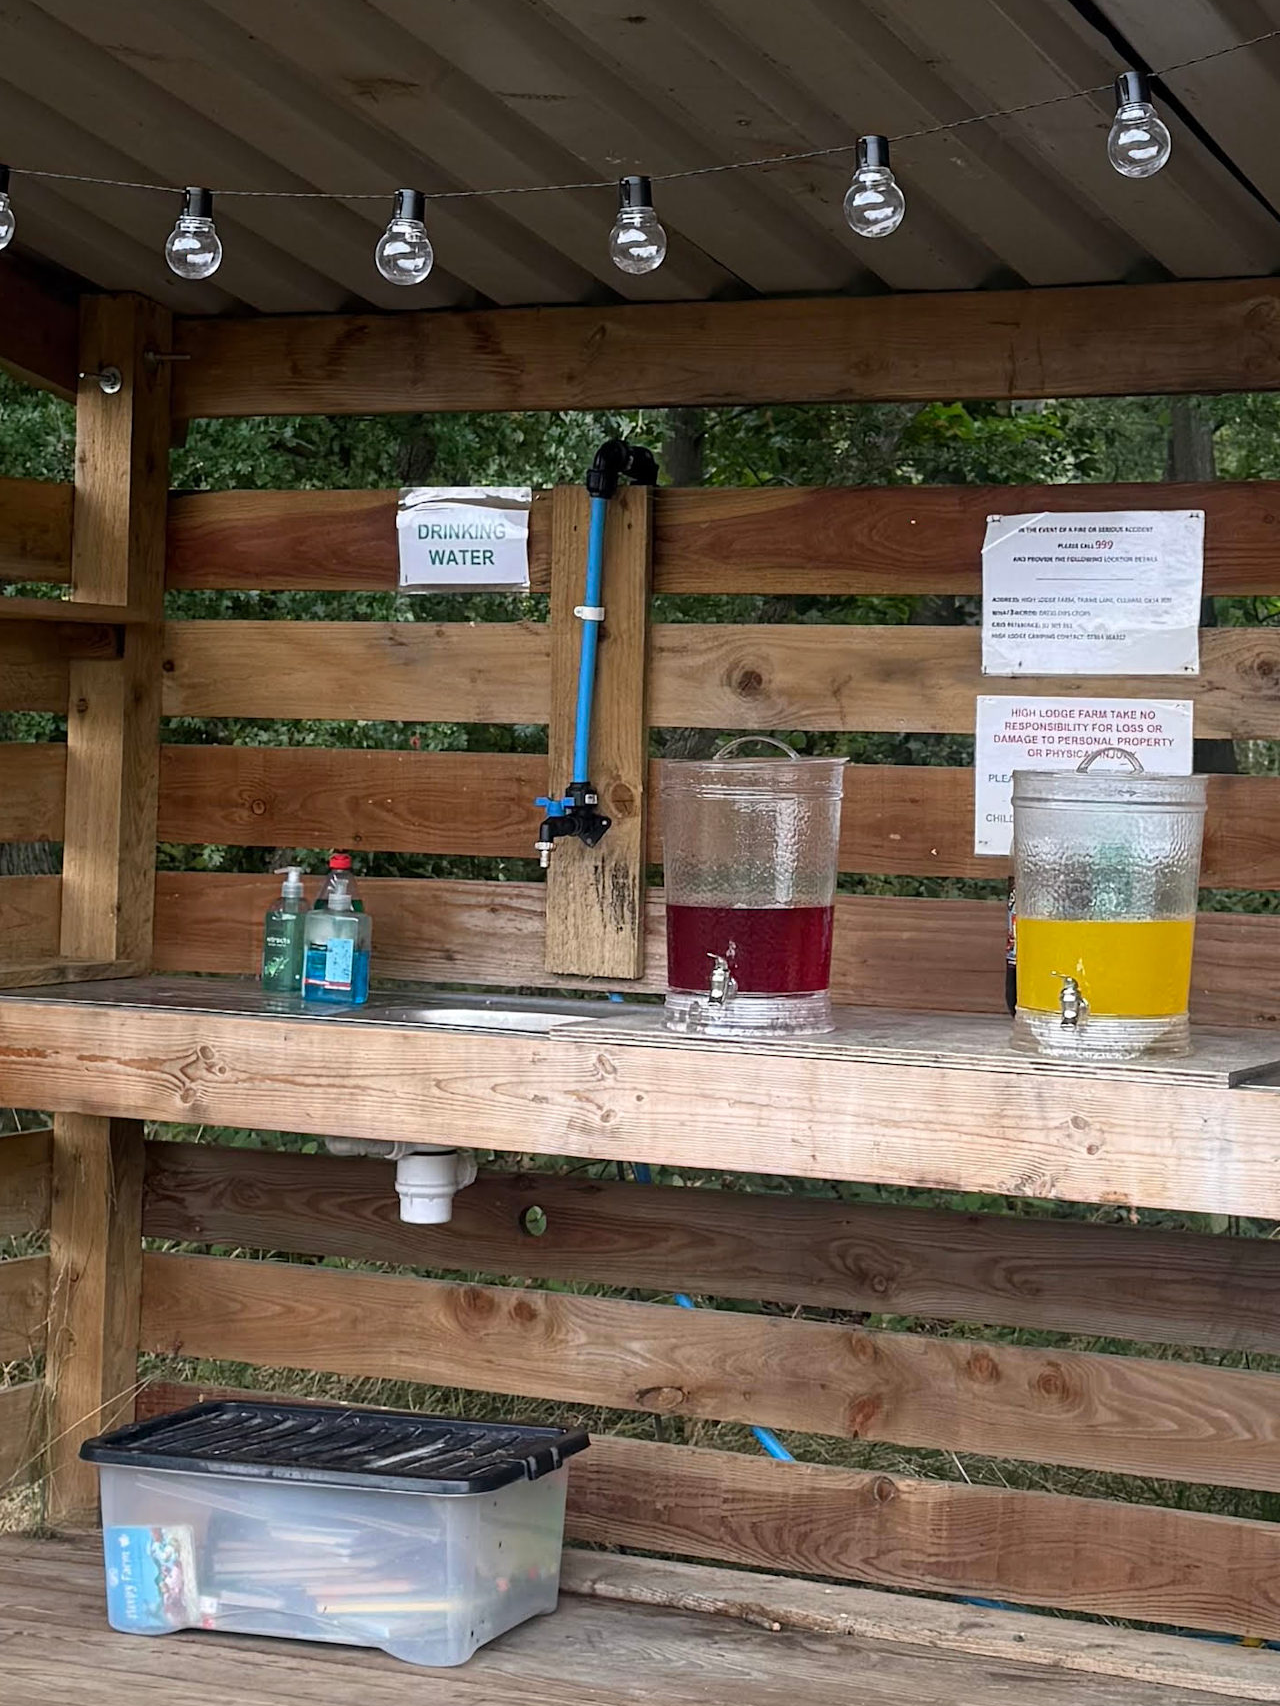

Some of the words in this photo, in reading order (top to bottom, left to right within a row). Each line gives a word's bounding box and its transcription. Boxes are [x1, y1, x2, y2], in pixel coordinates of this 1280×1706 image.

[418, 523, 506, 540] DRINKING
[1095, 540, 1114, 550] 999
[428, 549, 495, 566] WATER
[1011, 708, 1036, 717] HIGH
[1039, 709, 1075, 718] LODGE
[1078, 710, 1107, 719] FARM
[1110, 710, 1137, 719] TAKE
[1140, 711, 1156, 720] NO
[1004, 722, 1089, 731] RESPONSIBILITY
[1092, 723, 1113, 732] FOR
[1116, 724, 1144, 733] LOSS
[1146, 724, 1163, 733] OR
[993, 735, 1038, 744] DAMAGE
[1041, 736, 1055, 744] TO
[1057, 736, 1113, 746] PERSONAL
[1117, 737, 1175, 747] PROPERTY
[1027, 749, 1042, 757] OR
[1045, 749, 1097, 759] PHYSICA
